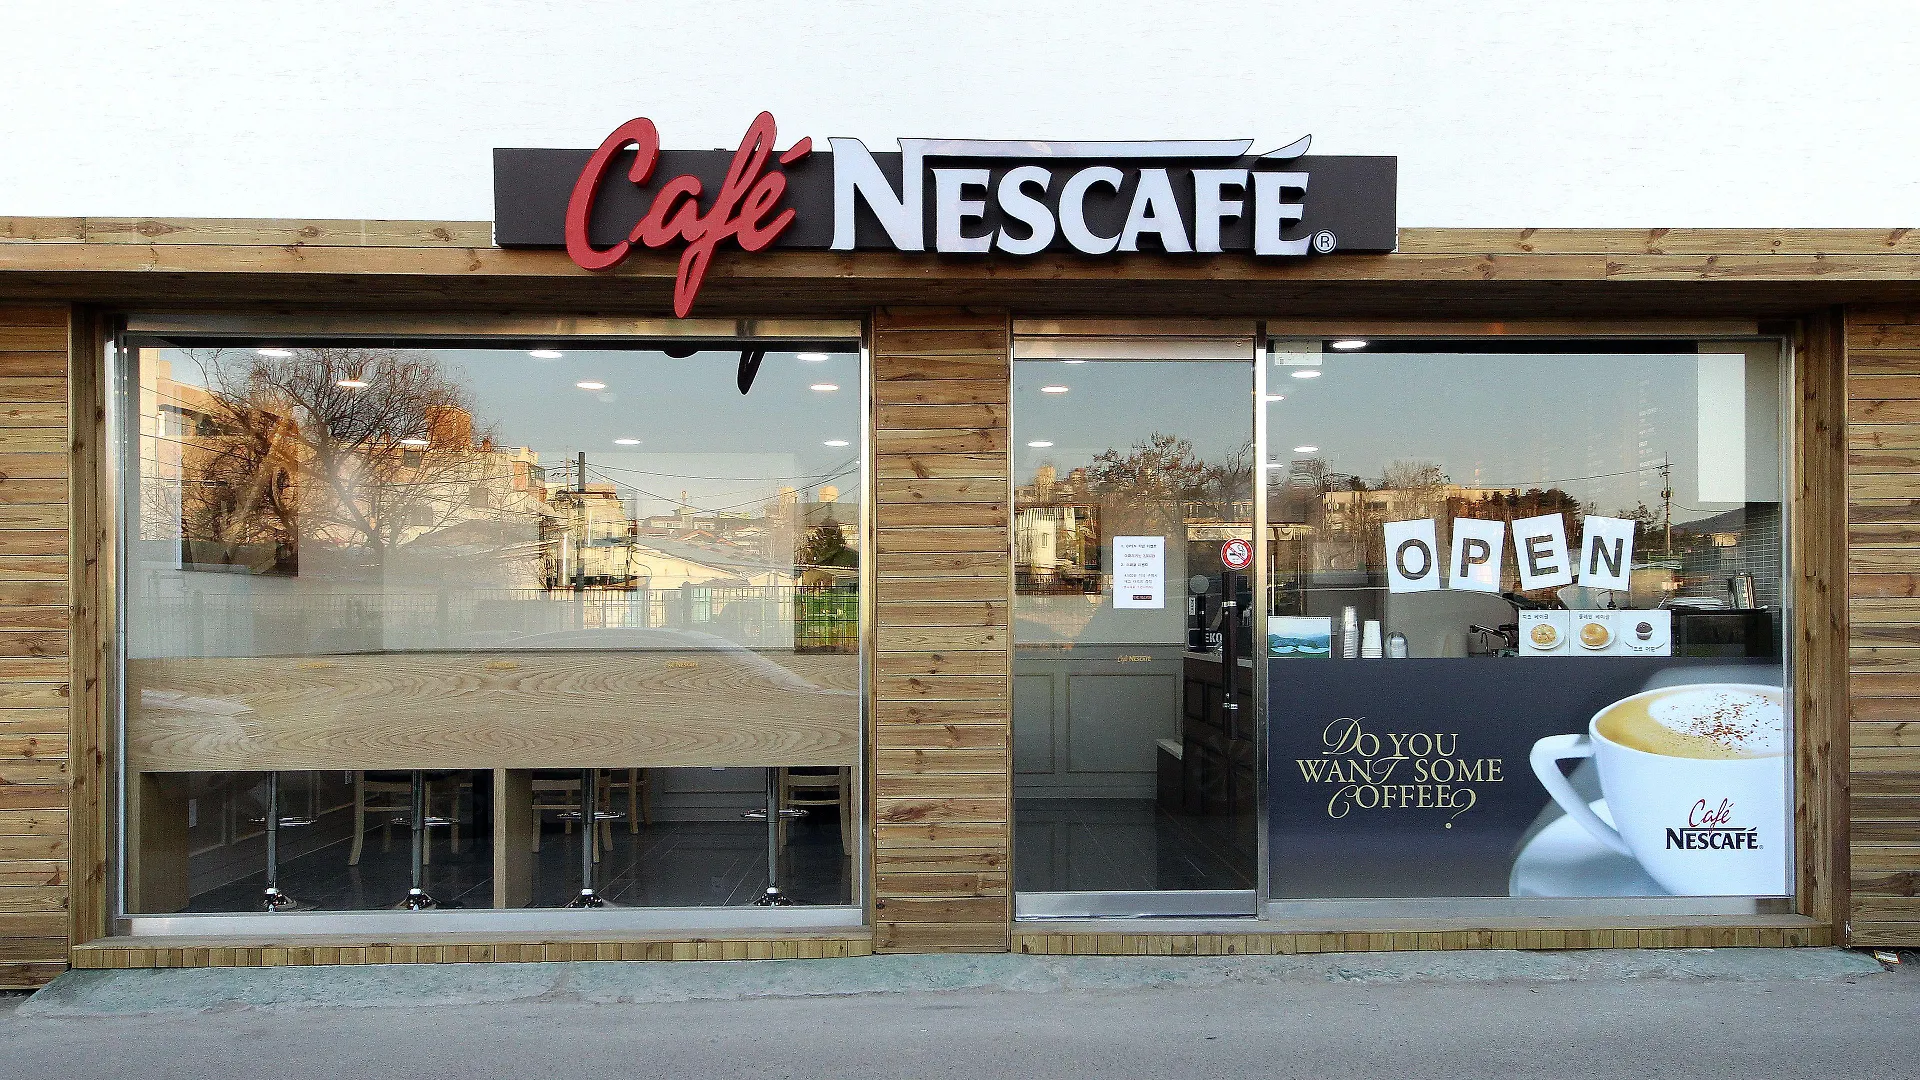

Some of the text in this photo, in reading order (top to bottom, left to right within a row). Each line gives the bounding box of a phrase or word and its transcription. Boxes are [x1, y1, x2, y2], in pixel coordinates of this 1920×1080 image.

[564, 110, 813, 318] Café
[1395, 534, 1625, 581] OPEN
[1387, 733, 1459, 757] YOU
[1295, 756, 1504, 784] WANT SOME
[1688, 797, 1735, 837] Café
